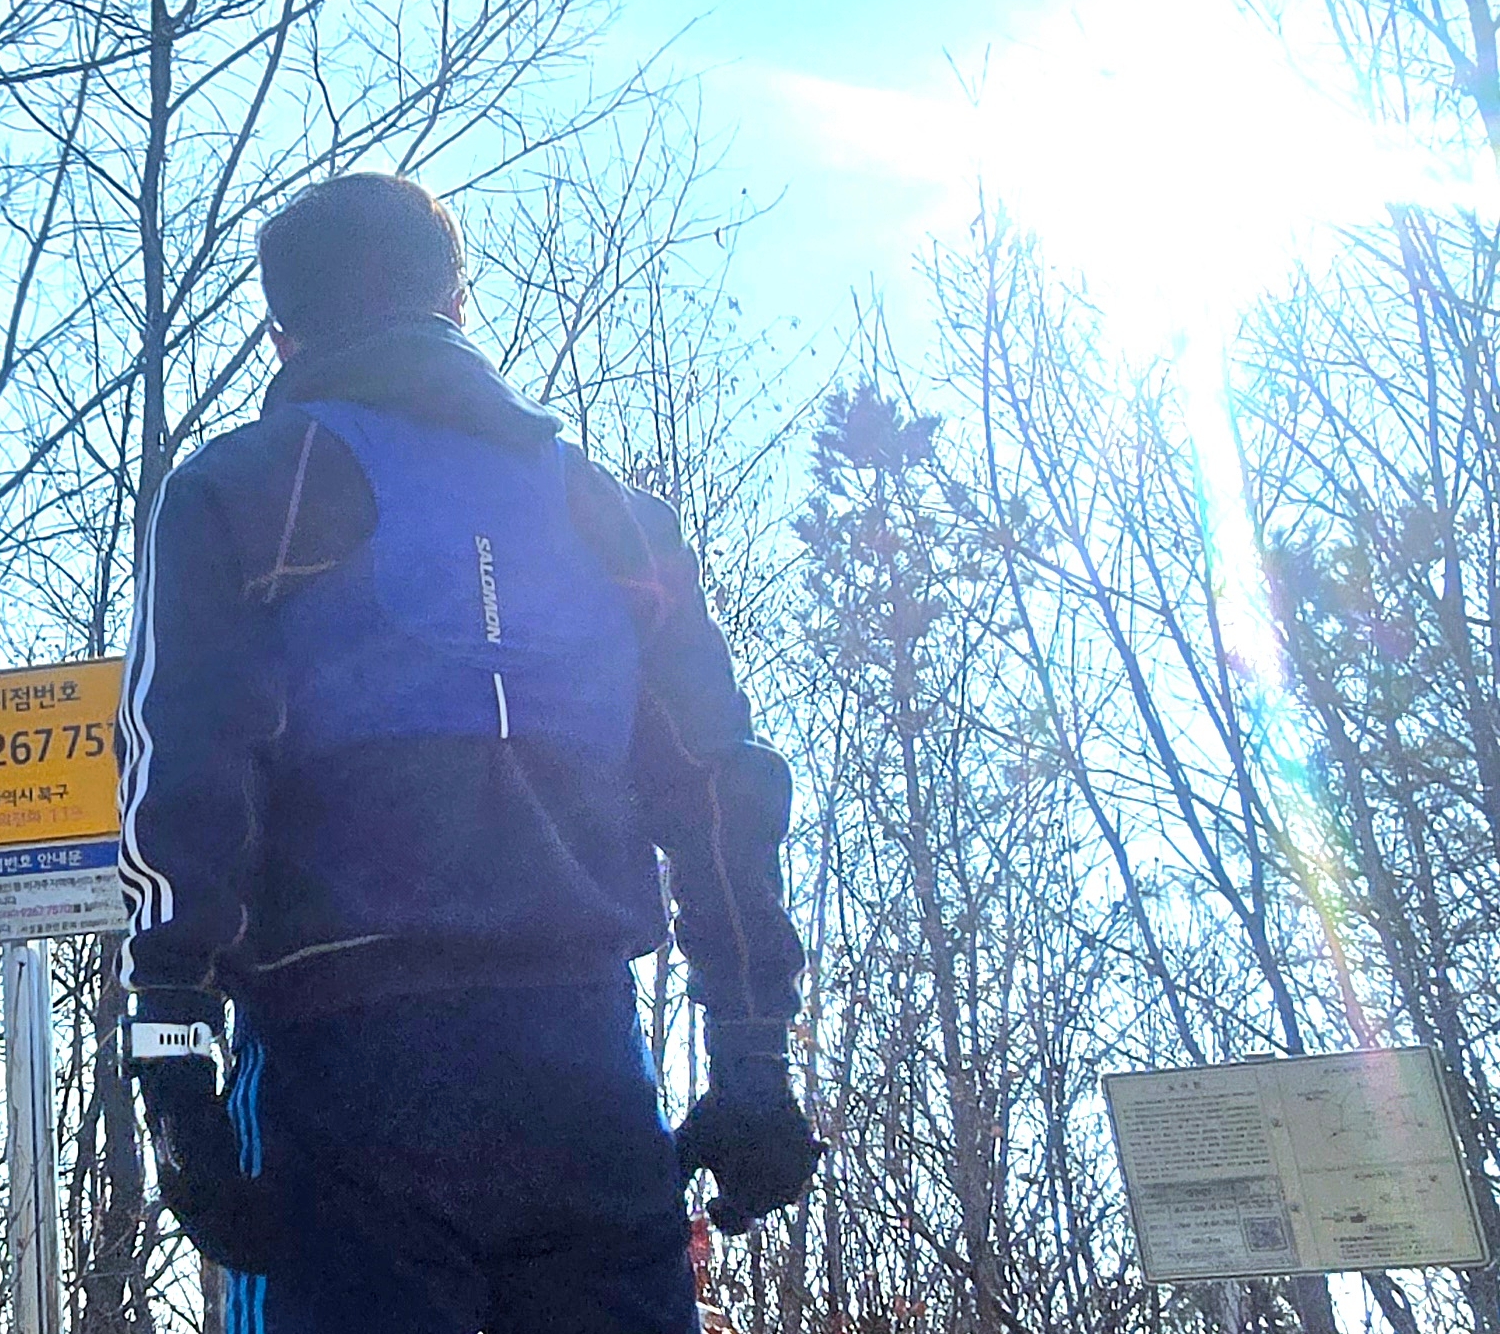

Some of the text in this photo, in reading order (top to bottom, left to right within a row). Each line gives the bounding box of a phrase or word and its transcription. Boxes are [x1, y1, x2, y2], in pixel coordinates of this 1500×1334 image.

[474, 534, 501, 644] SALOMON
[62, 721, 114, 760] 75
[37, 783, 70, 804] 북구
[36, 849, 84, 869] 안내문
